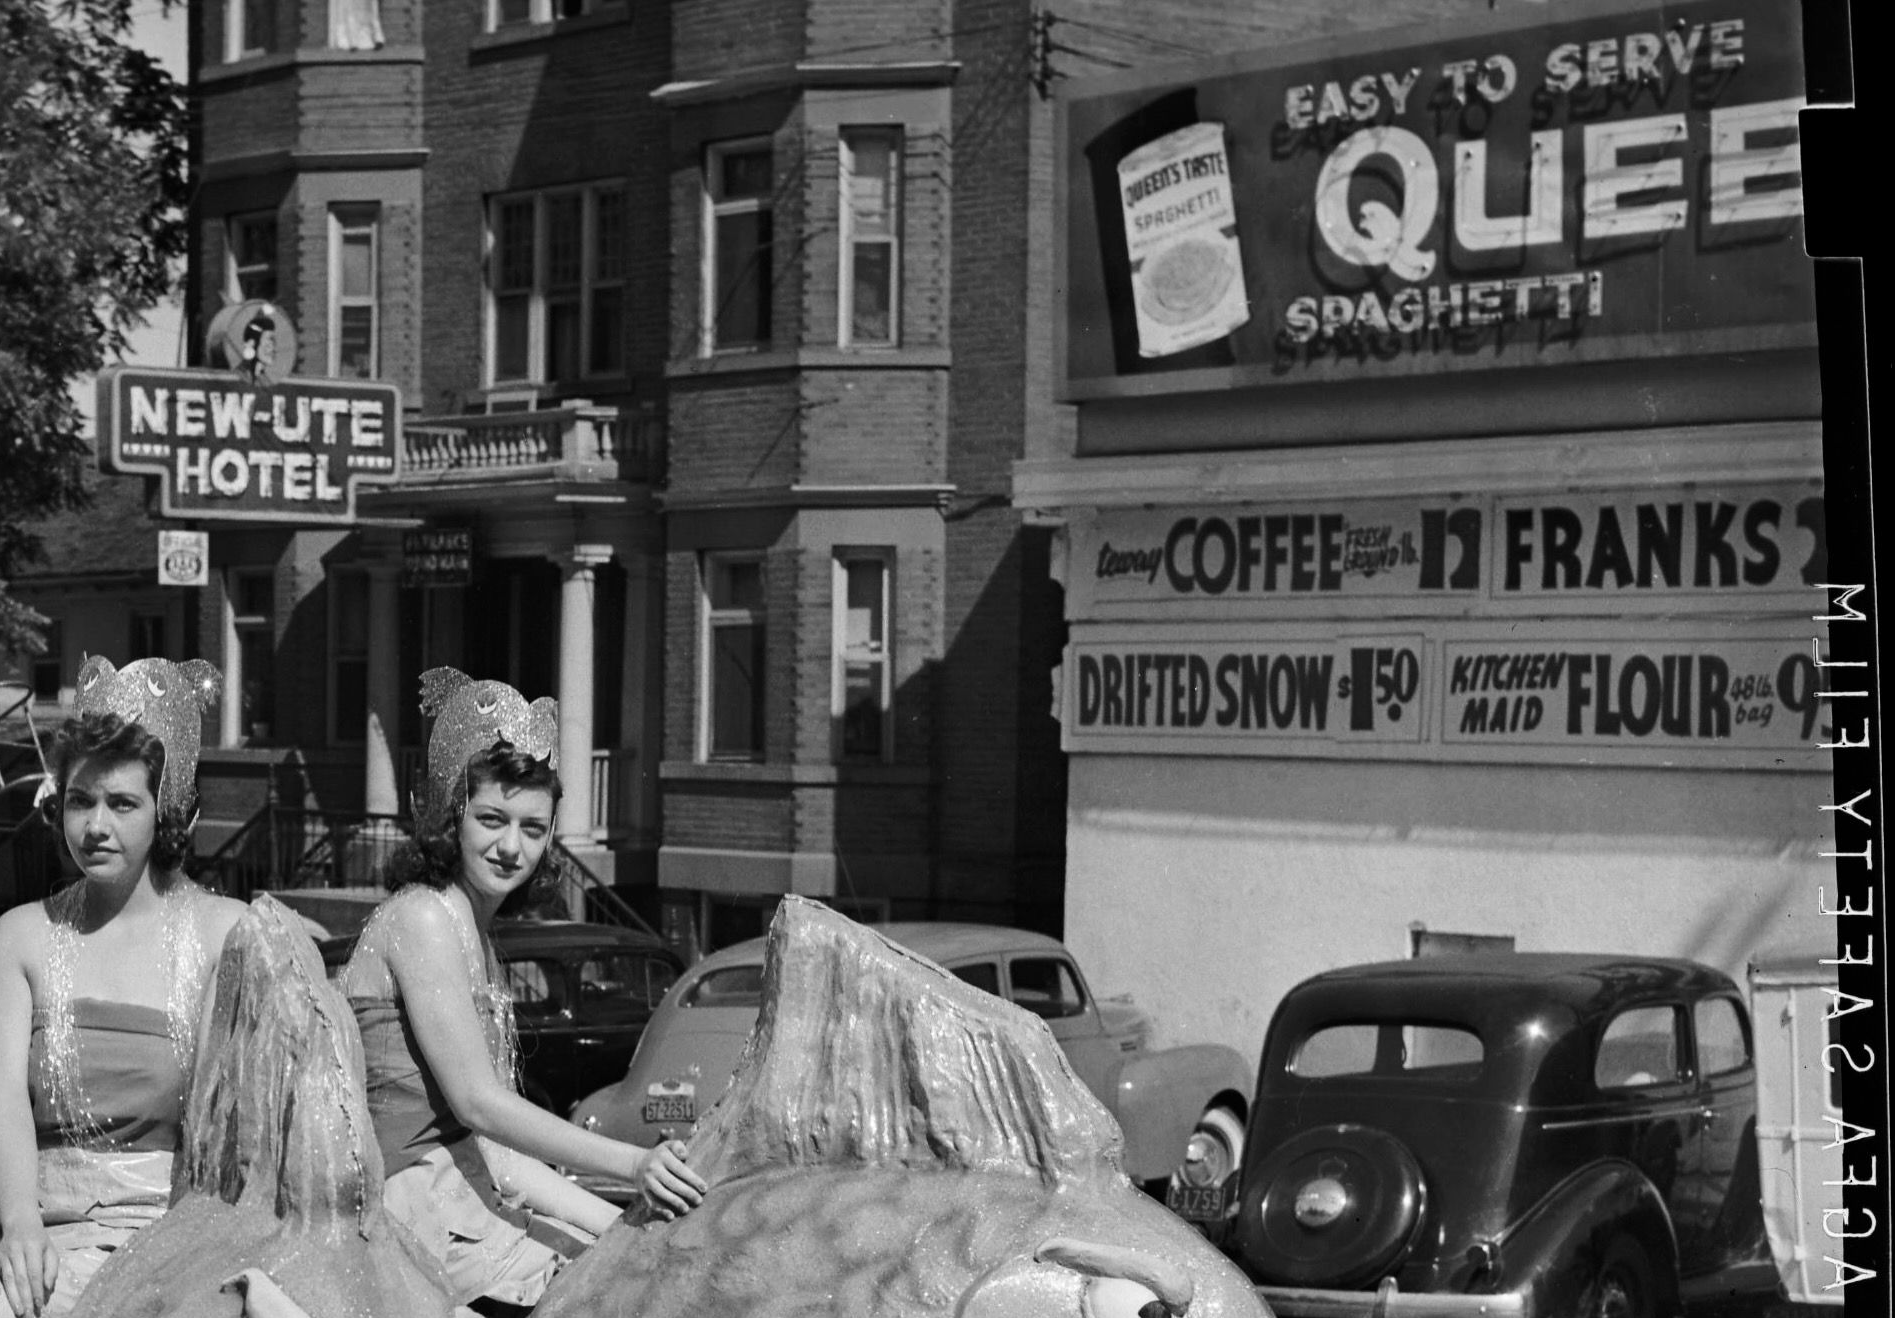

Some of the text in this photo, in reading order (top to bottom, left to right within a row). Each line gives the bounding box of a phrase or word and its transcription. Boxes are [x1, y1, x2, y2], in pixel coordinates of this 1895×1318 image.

[1285, 18, 1745, 129] EASY TO SERVE
[1182, 151, 1225, 181] TASTE
[1134, 186, 1222, 233] SPAGHETTI
[1285, 270, 1603, 343] SPAGHETTI
[129, 385, 384, 447] NEW-UTE
[175, 447, 343, 501] HOTEL
[1164, 513, 1344, 595] COFFEE
[1504, 501, 1782, 590] FRANKS
[1078, 653, 1210, 728] DRIFTED
[1215, 653, 1335, 731] SNOW
[1450, 653, 1567, 695] KITCHEN
[1566, 653, 1732, 738] FLOUR
[1459, 695, 1544, 735] MAID
[1735, 702, 1774, 729] bag
